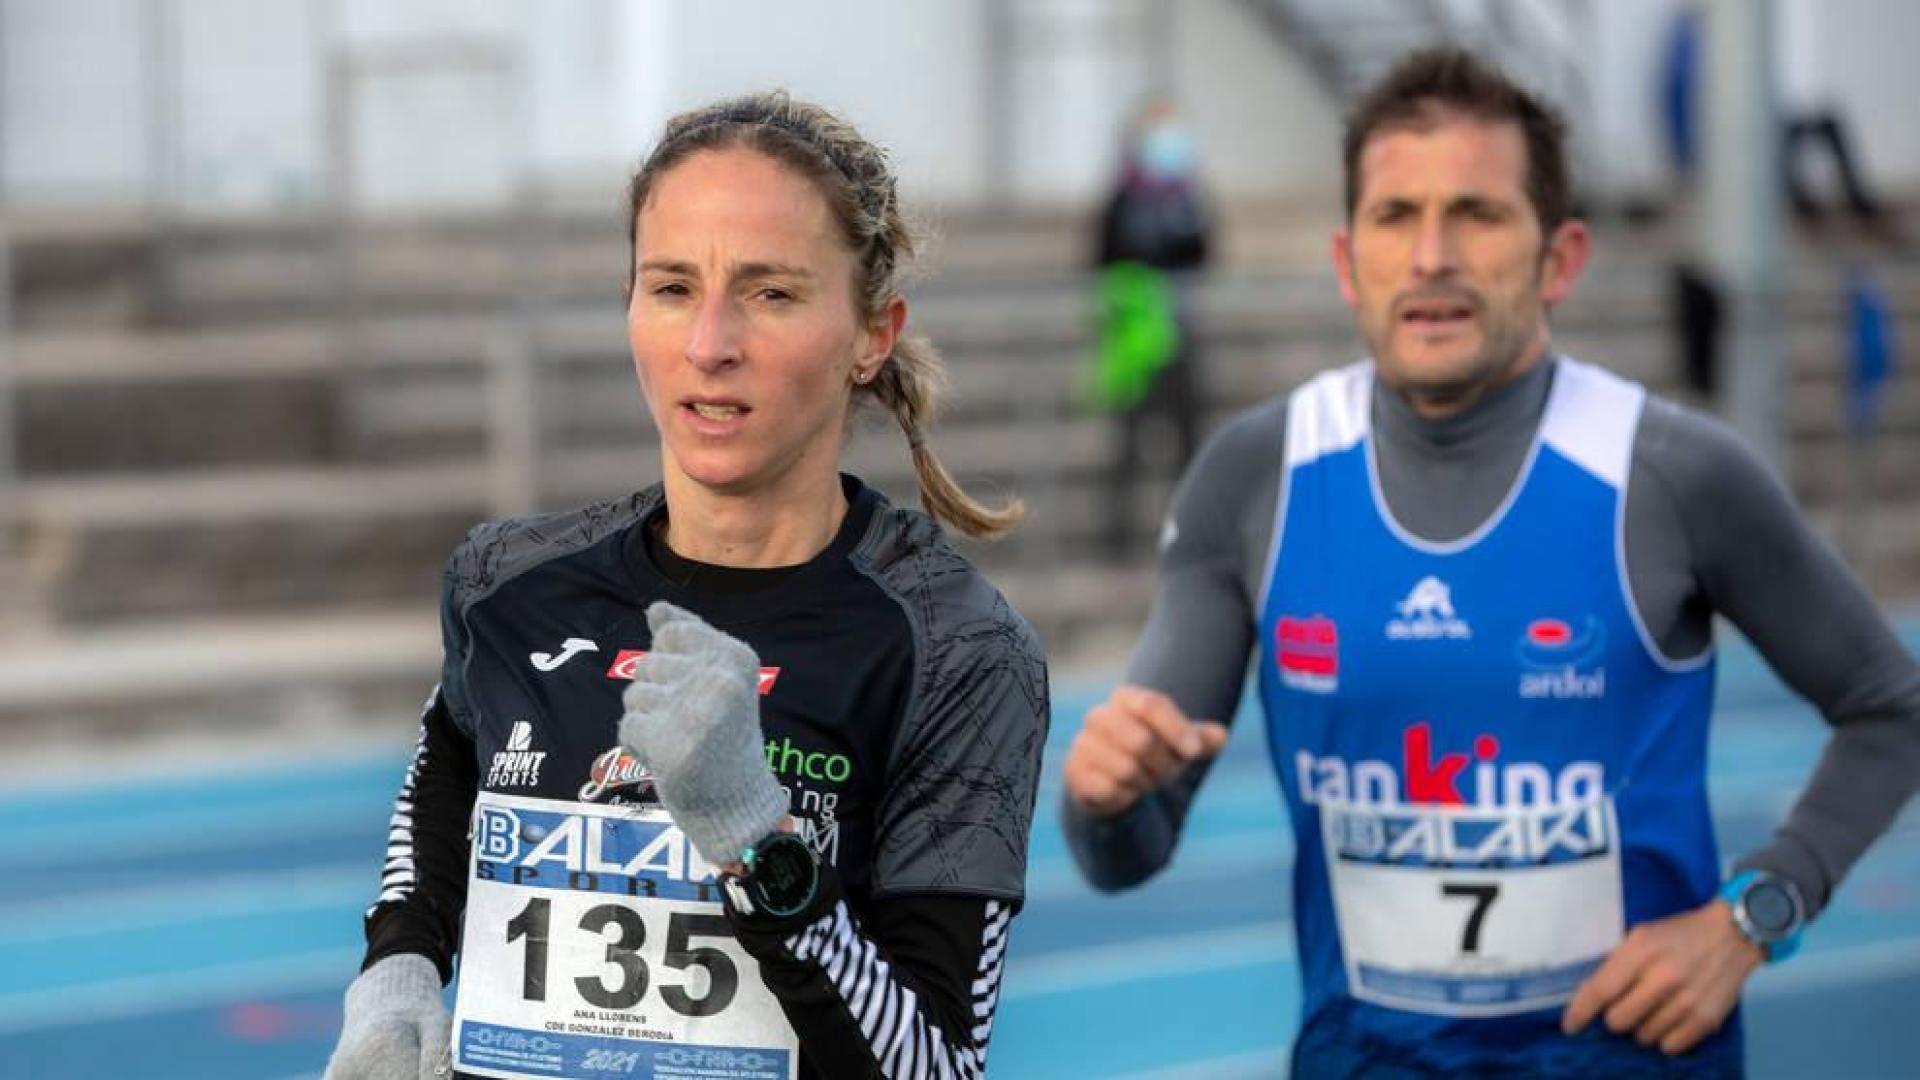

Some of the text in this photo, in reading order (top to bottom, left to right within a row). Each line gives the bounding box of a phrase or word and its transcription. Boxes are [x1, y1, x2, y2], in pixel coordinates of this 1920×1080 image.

[491, 751, 547, 776] SPRINT
[764, 737, 852, 782] thco
[1441, 883, 1500, 952] 7
[505, 897, 739, 1018] 135
[567, 1023, 625, 1036] GONZALEZ
[573, 1010, 647, 1025] ANA LLORENS
[580, 1048, 641, 1073] 2021
